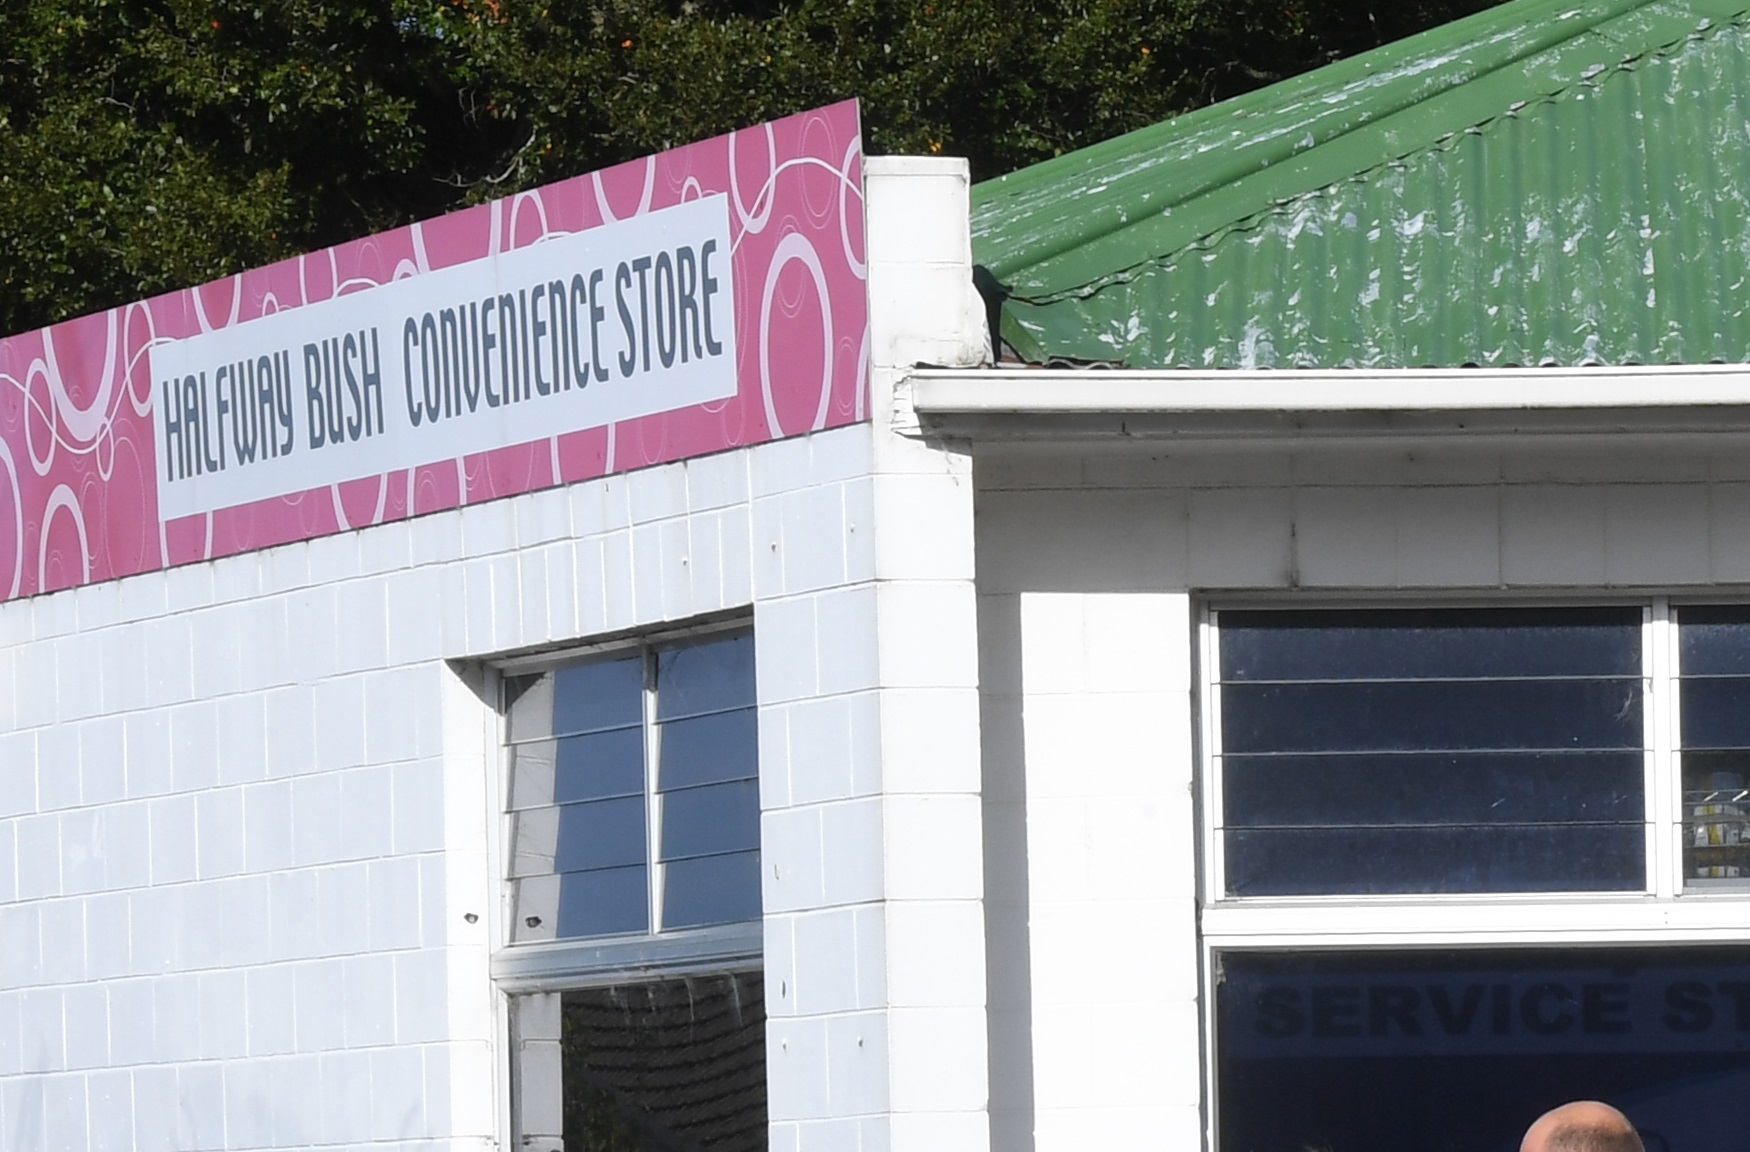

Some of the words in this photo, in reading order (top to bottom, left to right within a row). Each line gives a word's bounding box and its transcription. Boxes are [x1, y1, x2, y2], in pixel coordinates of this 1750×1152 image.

[162, 350, 294, 482] HALFWAY
[303, 326, 386, 450] BUSH
[402, 268, 610, 428] CONVENIENCE
[615, 238, 724, 379] STORE
[1254, 981, 1632, 1042] SERVICE
